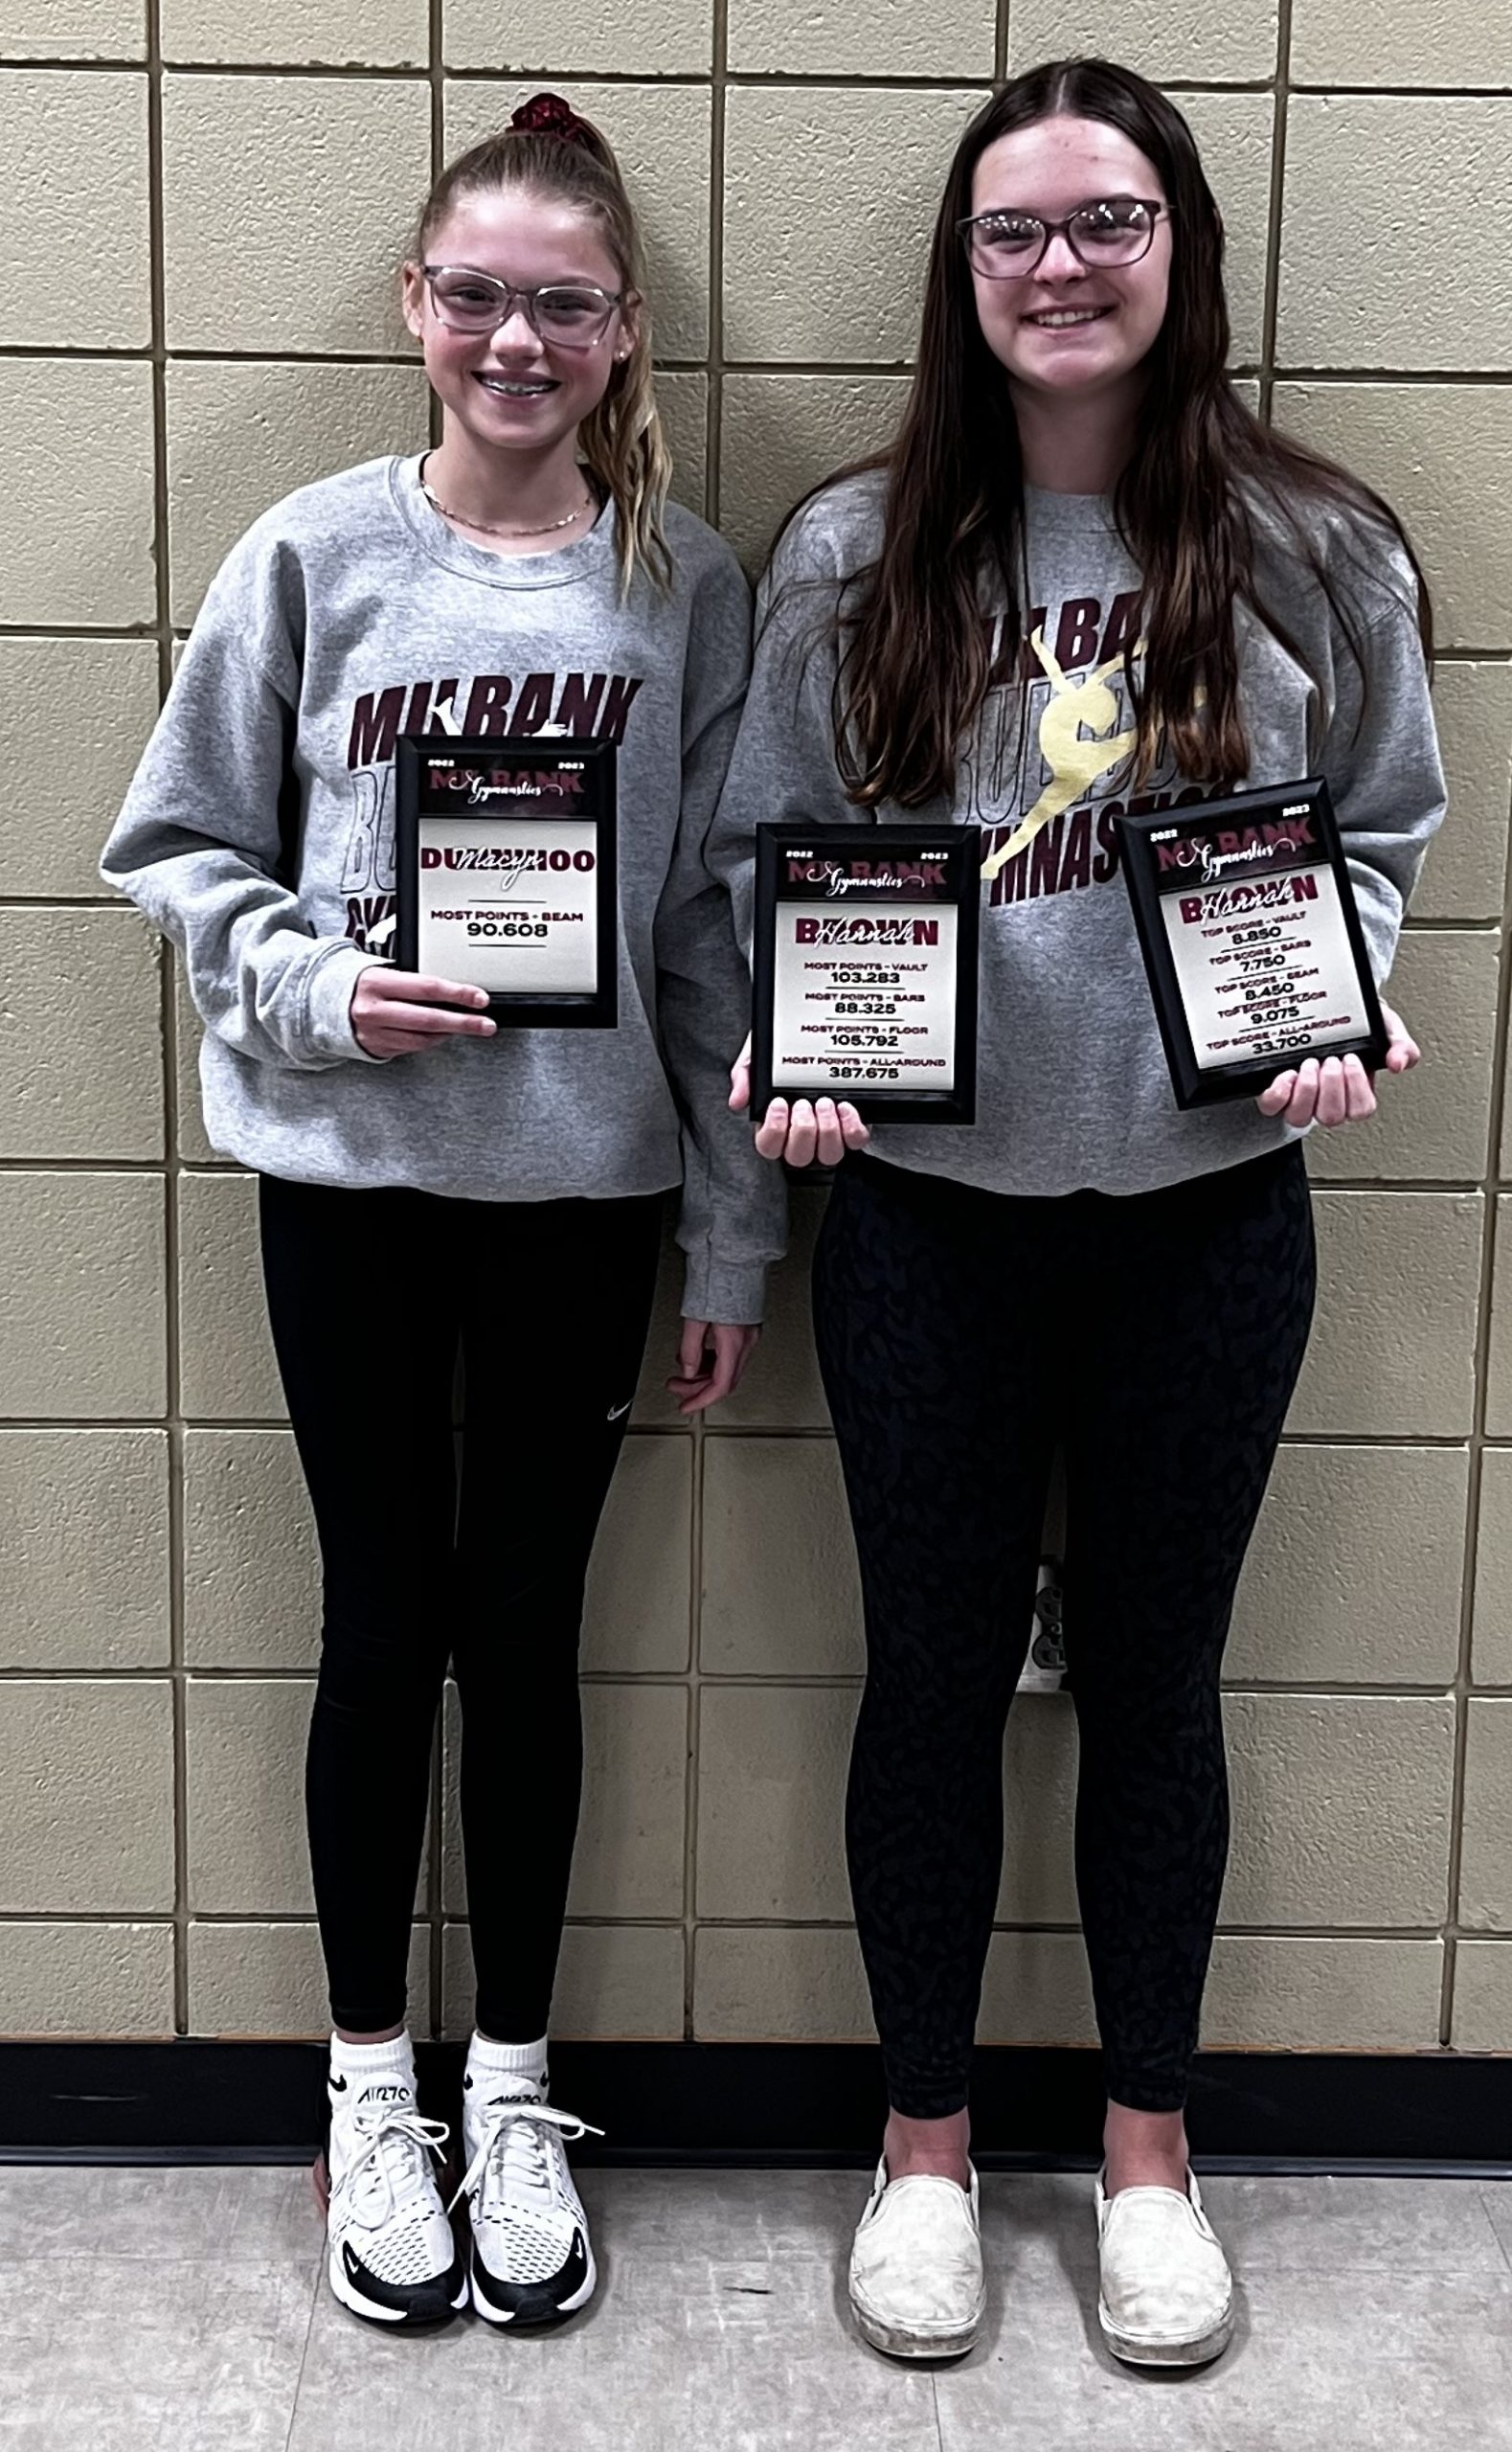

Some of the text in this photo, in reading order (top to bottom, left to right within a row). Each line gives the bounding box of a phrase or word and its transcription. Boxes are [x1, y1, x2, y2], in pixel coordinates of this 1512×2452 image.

[431, 911, 472, 920] MOST
[475, 911, 529, 920] POINTS
[541, 912, 583, 921] BEAM
[1201, 927, 1224, 938] TOP
[1226, 920, 1264, 934] SCORE
[1272, 911, 1306, 923] VAULT
[467, 922, 548, 938] 90.608
[1231, 926, 1281, 944] 8.850
[1209, 955, 1231, 965] TOP
[1233, 947, 1272, 961] SCORE
[1280, 940, 1311, 952] BARS
[1239, 954, 1285, 972] 7.750
[831, 972, 900, 983] 103.283
[1214, 984, 1237, 994] TOP
[1239, 976, 1277, 989] SCORE
[1286, 967, 1319, 980] BEAM
[1245, 982, 1295, 1001] 8.450
[835, 1003, 896, 1014] 88.325
[1217, 1005, 1240, 1018] TOP
[1242, 998, 1279, 1013] SCORE
[1289, 990, 1327, 1005] FLOOR
[1251, 1006, 1299, 1024] 9.075
[890, 1026, 928, 1034] FLOOR
[1207, 1040, 1229, 1051] TOP
[1231, 1032, 1270, 1046] SCORE
[1278, 1016, 1351, 1036] ALL-AROUND
[830, 1034, 898, 1046] 105.792
[1252, 1033, 1311, 1054] 33.700
[782, 1056, 815, 1065] MOST
[870, 1058, 946, 1067] ALL-AROUND
[829, 1067, 899, 1078] 387.675
